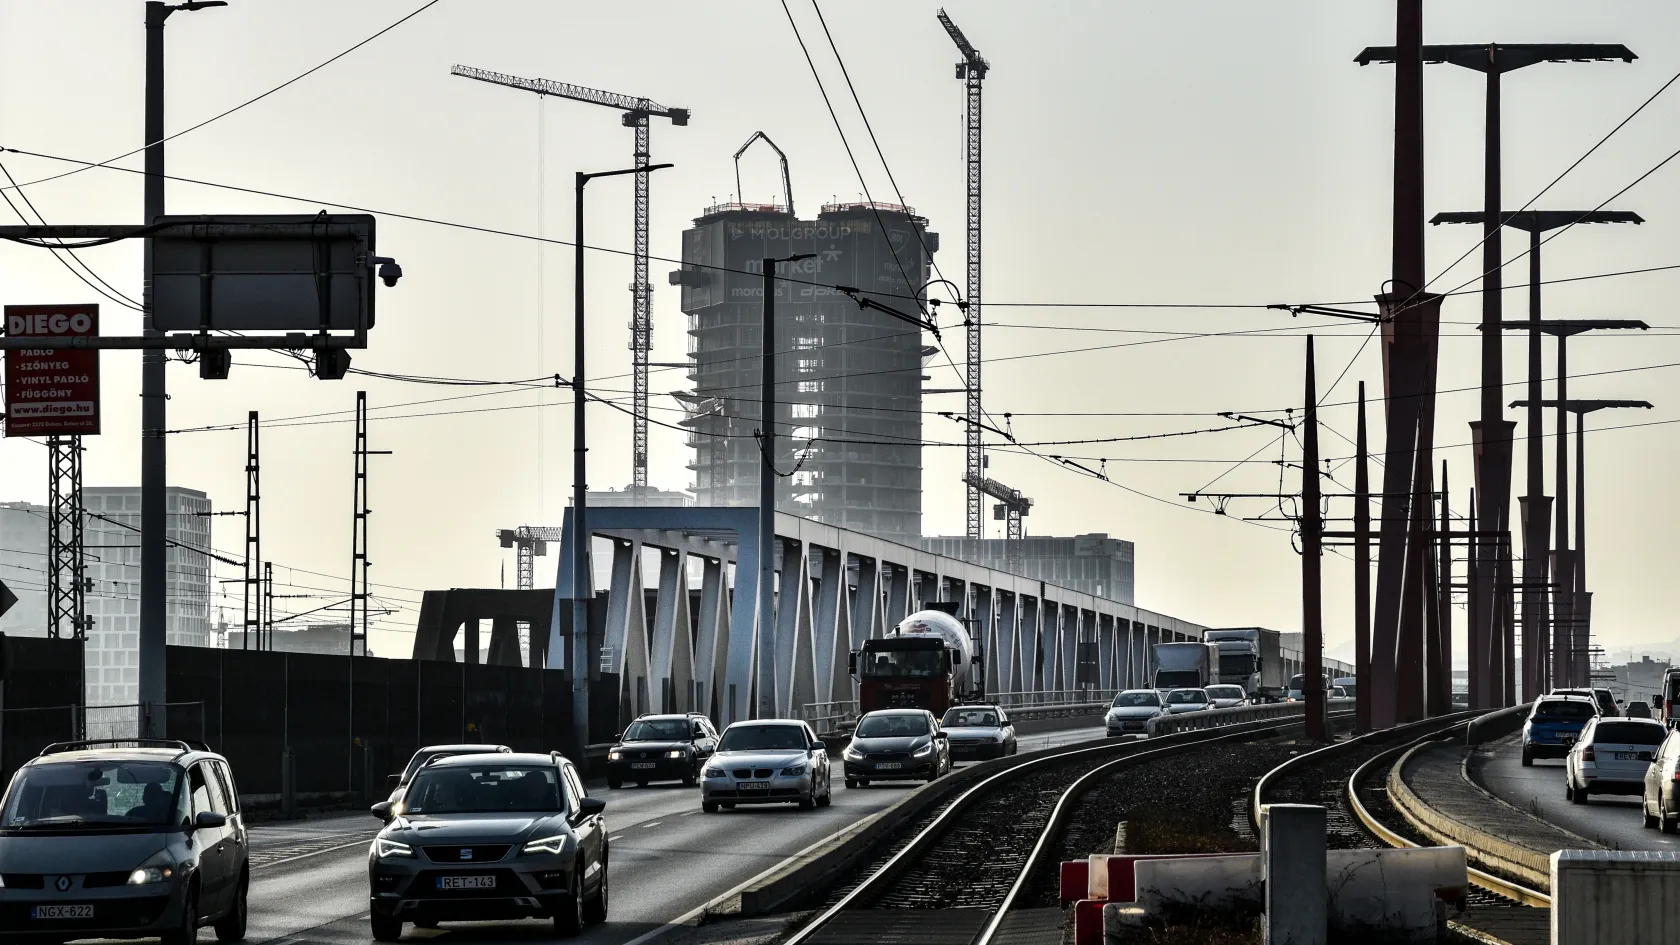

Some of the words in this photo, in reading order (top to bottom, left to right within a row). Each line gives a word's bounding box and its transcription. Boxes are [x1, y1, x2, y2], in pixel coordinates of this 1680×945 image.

[745, 255, 824, 274] mrket
[8, 313, 92, 335] DIEGO
[20, 376, 52, 384] VINYL
[53, 373, 89, 384] PADLÓ
[21, 387, 73, 399] FÜGGÖNY
[14, 404, 90, 414] www.diego.hu
[444, 877, 494, 888] RET-143
[39, 906, 92, 917] NGX-622
